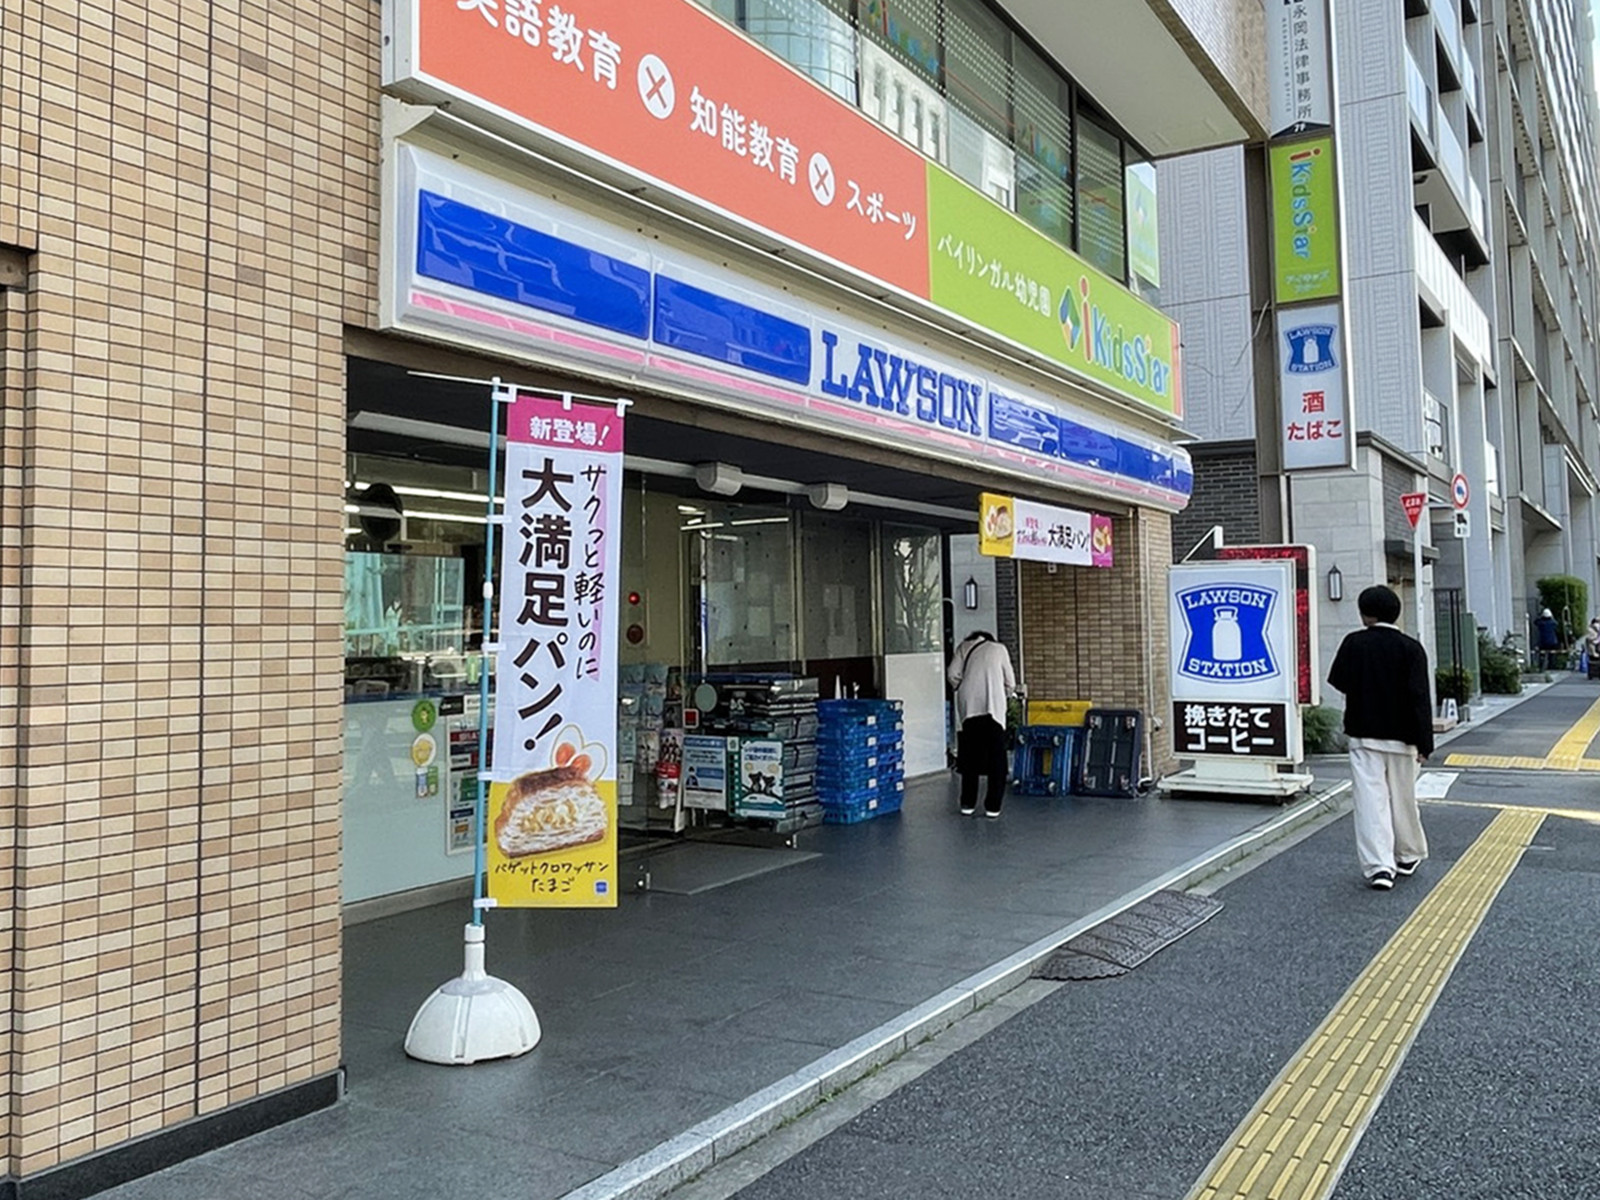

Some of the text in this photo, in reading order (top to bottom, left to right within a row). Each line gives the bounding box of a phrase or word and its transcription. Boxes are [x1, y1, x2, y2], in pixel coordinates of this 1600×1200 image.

[1293, 5, 1313, 119] 永岡法律事務所
[690, 85, 800, 185] 知能教育
[846, 179, 917, 241] スポーツ
[1288, 327, 1332, 341] LAWSON
[1290, 359, 1333, 373] STATION
[821, 330, 983, 437] LAWSON
[1302, 391, 1326, 414] 酒
[530, 415, 609, 447] 新登場!
[1287, 419, 1343, 441] たばこ
[573, 464, 607, 681] サクっと軽いのに
[512, 457, 574, 752] 大満足パン!
[1184, 589, 1268, 610] LAWSON
[1187, 657, 1269, 678] STATION
[1184, 704, 1272, 729] 挽きたて
[1186, 727, 1275, 754] コーヒー
[531, 876, 575, 893] たまご
